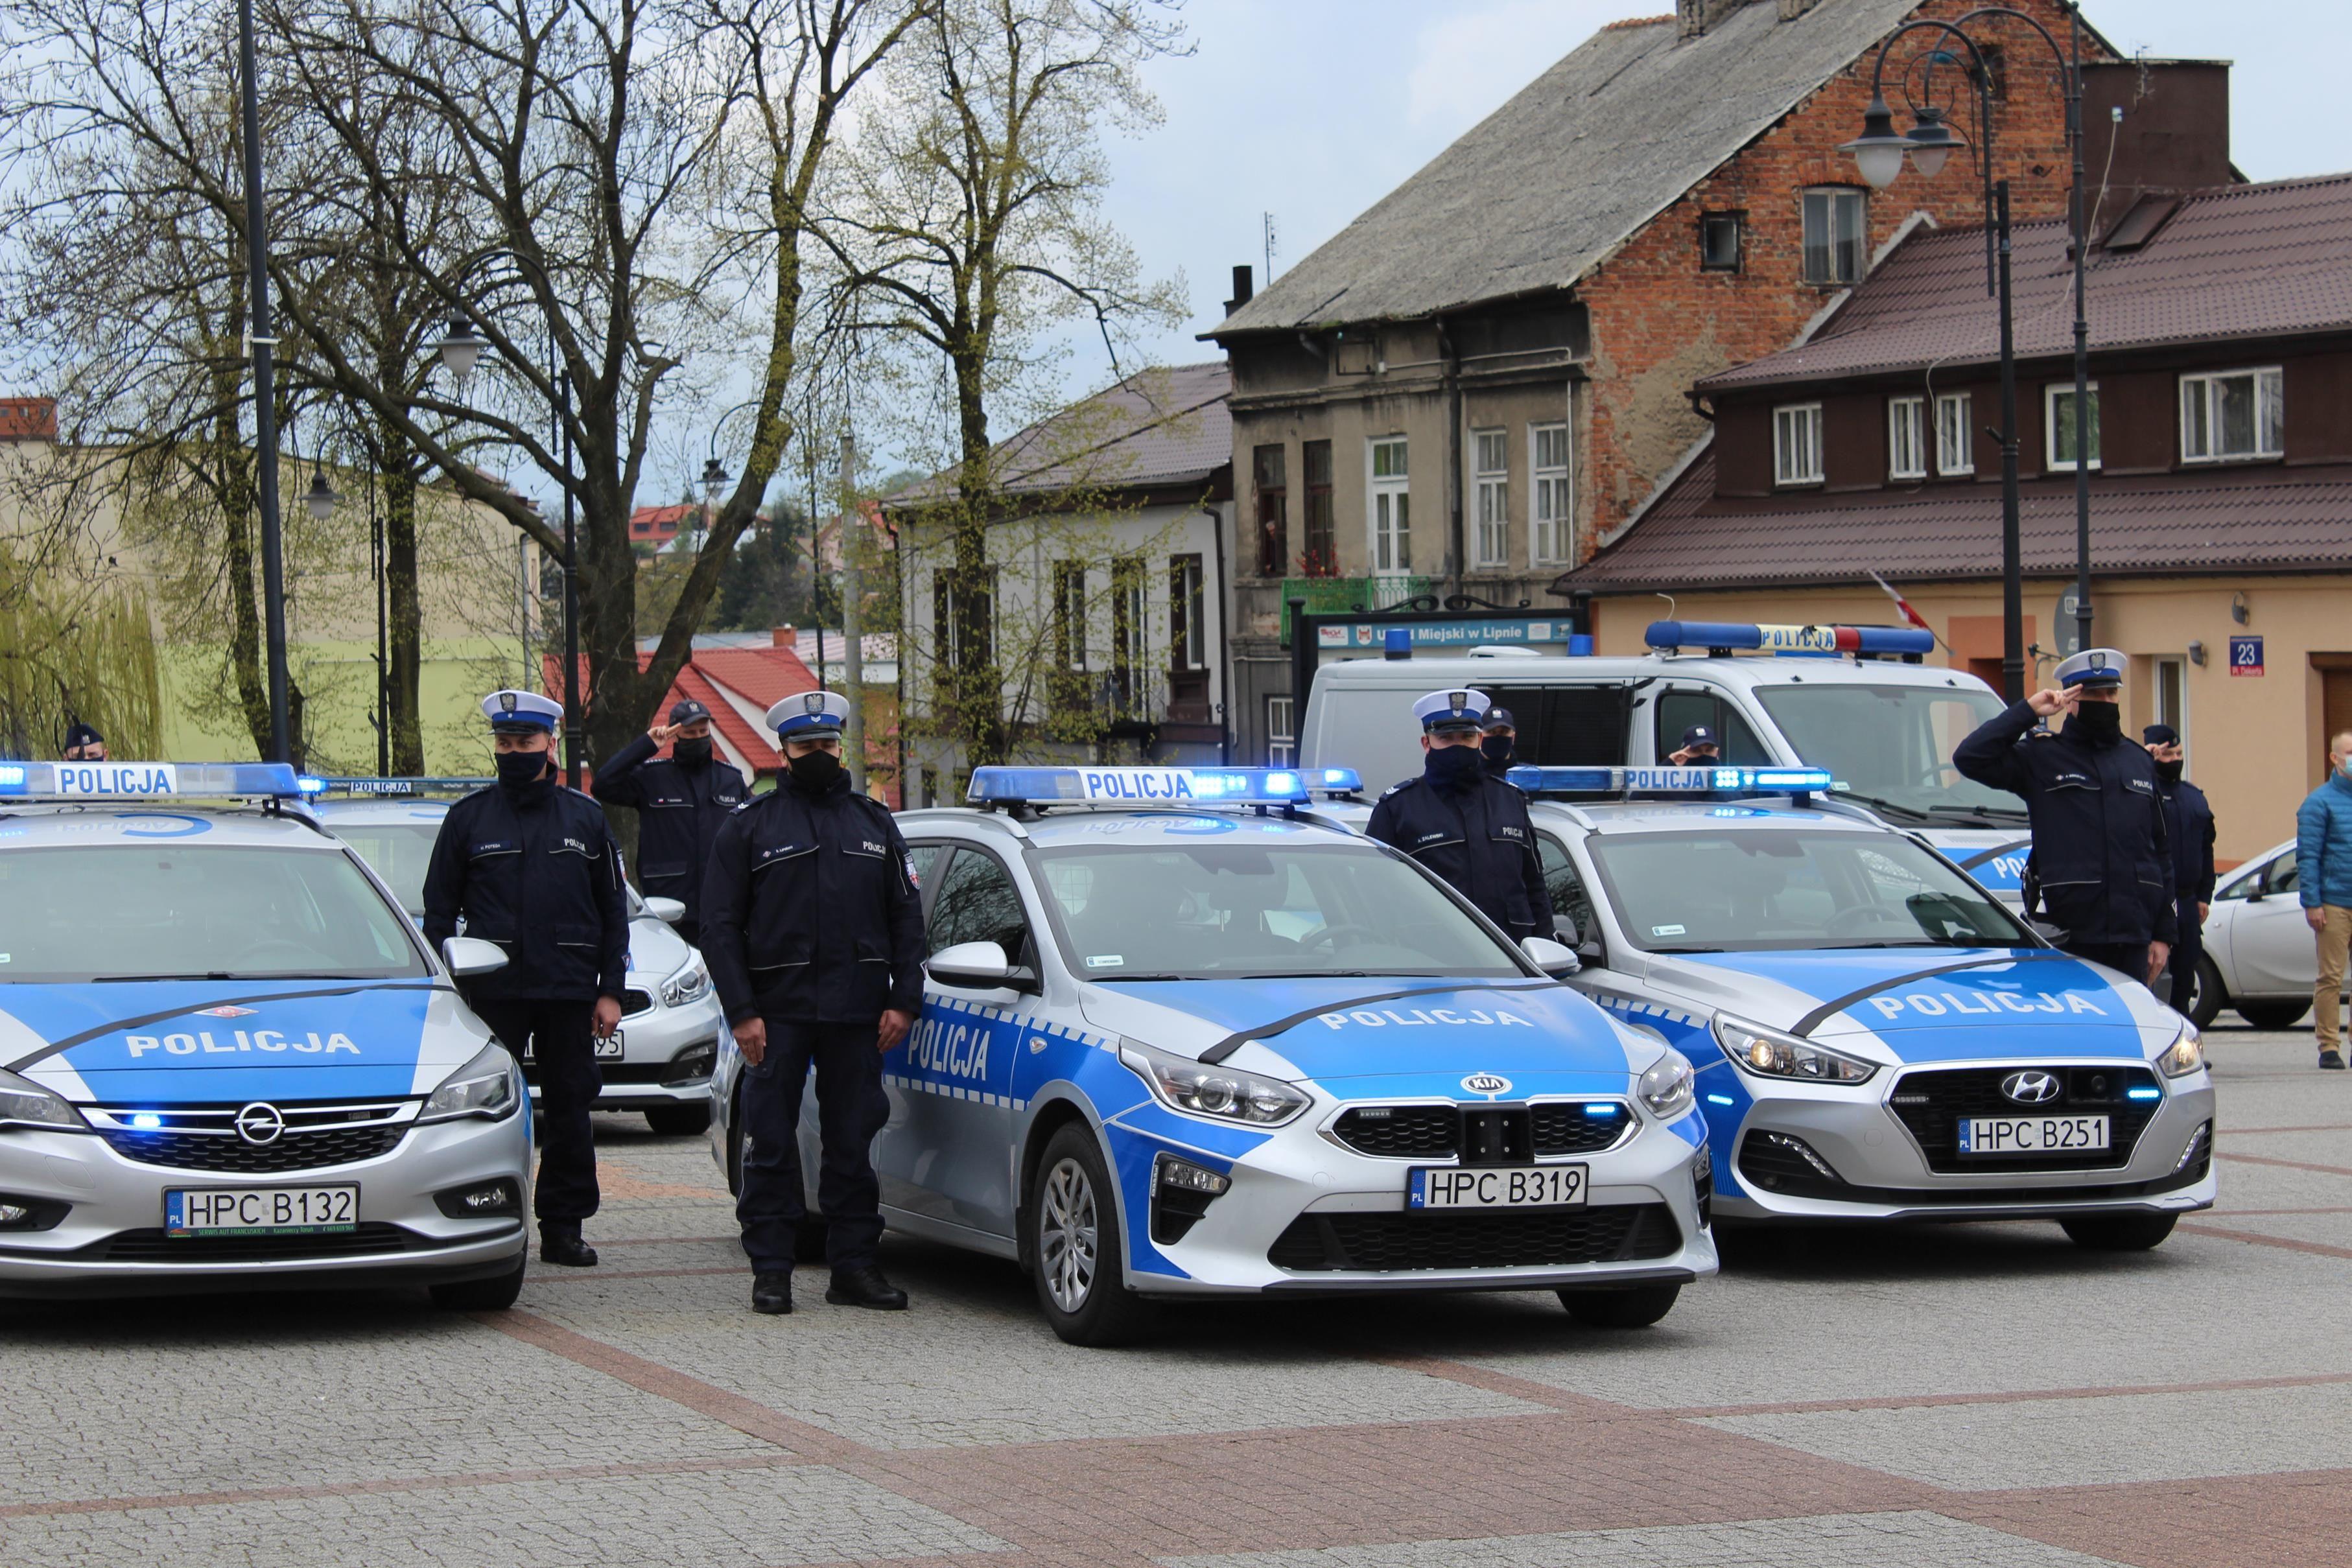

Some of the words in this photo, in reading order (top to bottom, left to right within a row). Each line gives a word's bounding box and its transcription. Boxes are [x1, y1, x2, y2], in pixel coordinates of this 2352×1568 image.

[1418, 627, 1464, 642] Miejski
[1468, 629, 1479, 639] w
[1483, 626, 1522, 640] Lipnie
[1762, 629, 1834, 648] POLICJA
[2238, 644, 2255, 665] 23
[60, 769, 172, 793] POLICJA
[353, 782, 408, 791] POLICJA
[1087, 773, 1194, 798] POLICJA
[1627, 771, 1704, 789] POLICJA
[1867, 992, 2108, 1020] POLICJA
[1317, 1009, 1535, 1029] POLICJA
[126, 1031, 361, 1057] POLICJA
[908, 1018, 991, 1081] POLICJA
[1472, 1078, 1501, 1088] KIA
[1975, 1121, 2032, 1150] HPC
[2043, 1119, 2102, 1148] B251
[1412, 1193, 1423, 1202] PL
[1430, 1173, 1498, 1204] HPC
[1509, 1170, 1581, 1203] B319
[170, 1215, 181, 1224] PL
[189, 1194, 259, 1225] HPC
[274, 1191, 351, 1224] B132
